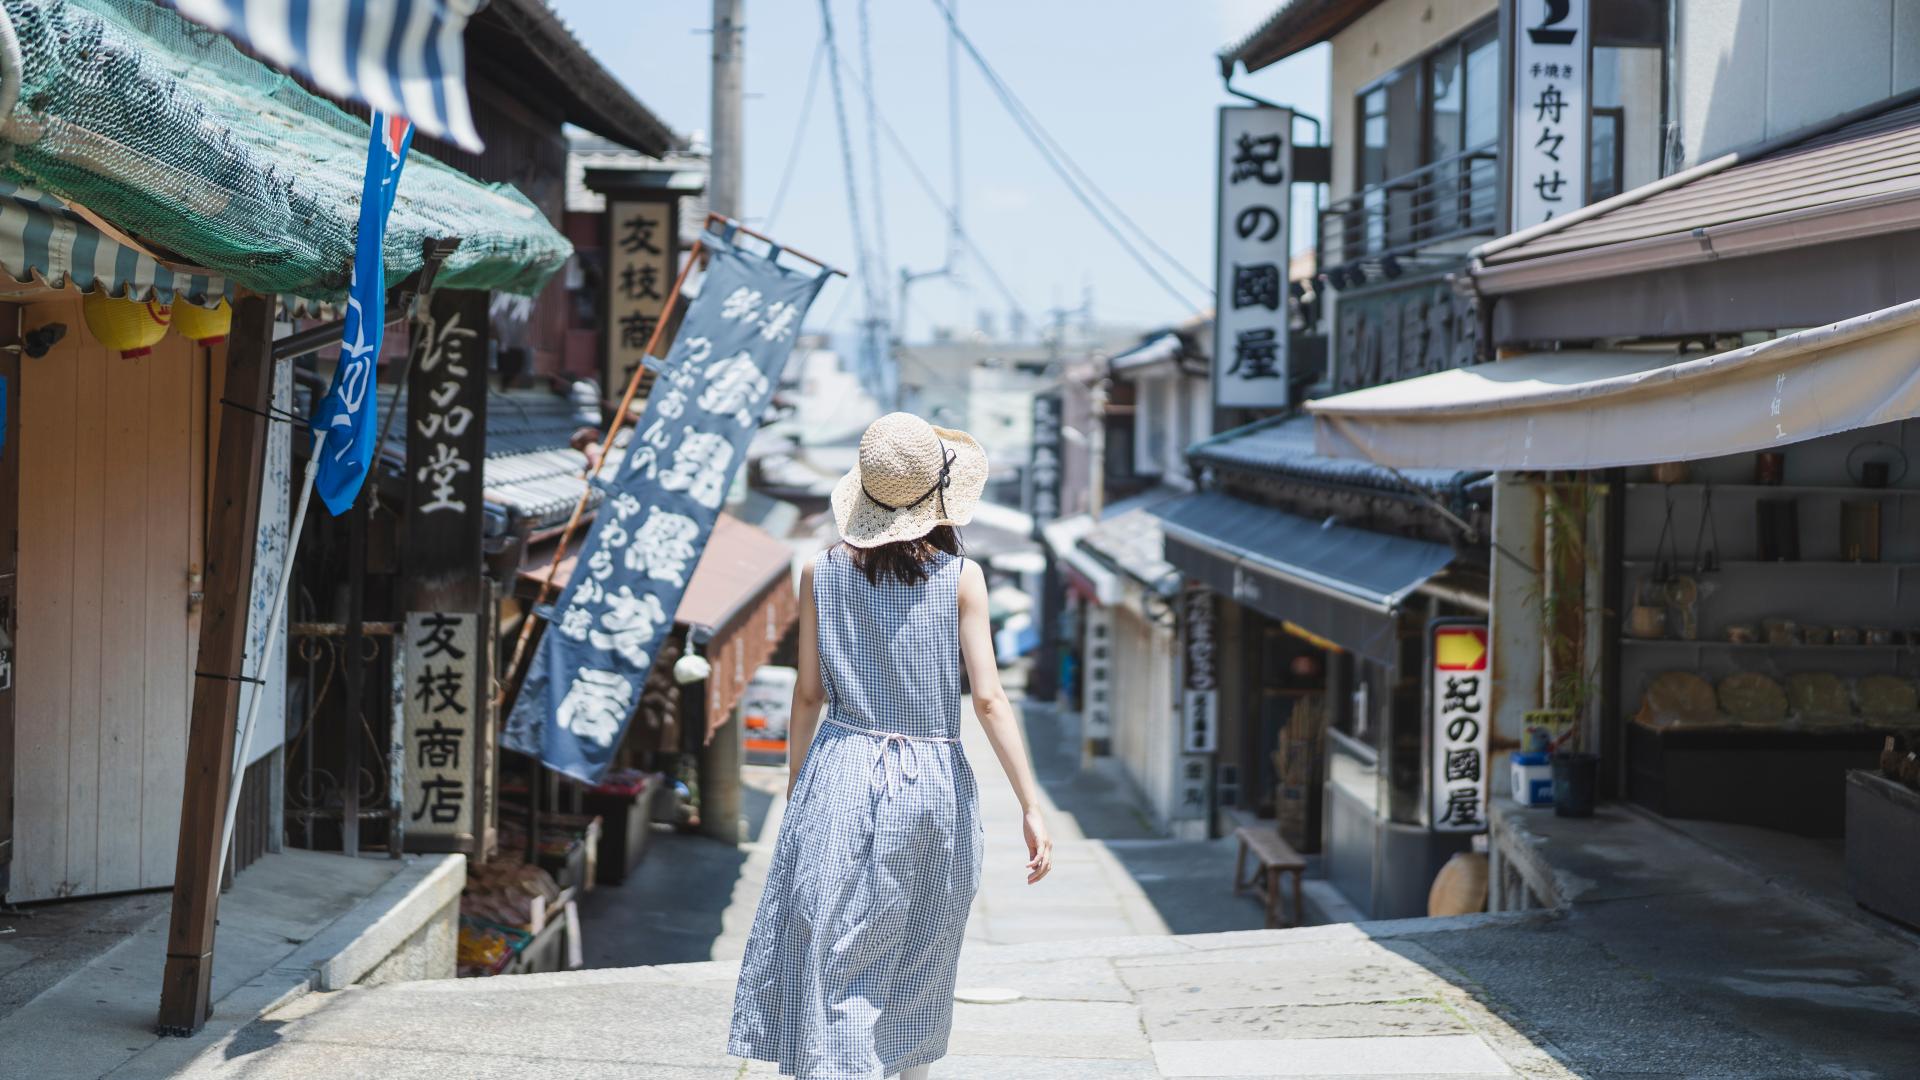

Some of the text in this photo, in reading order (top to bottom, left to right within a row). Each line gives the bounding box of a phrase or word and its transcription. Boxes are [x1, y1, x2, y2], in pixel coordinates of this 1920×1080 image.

[1530, 62, 1574, 79] 手焼き
[1226, 132, 1284, 380] 紀の國屋
[411, 612, 466, 824] 友枝商店
[1438, 675, 1481, 826] 紀の國屋
